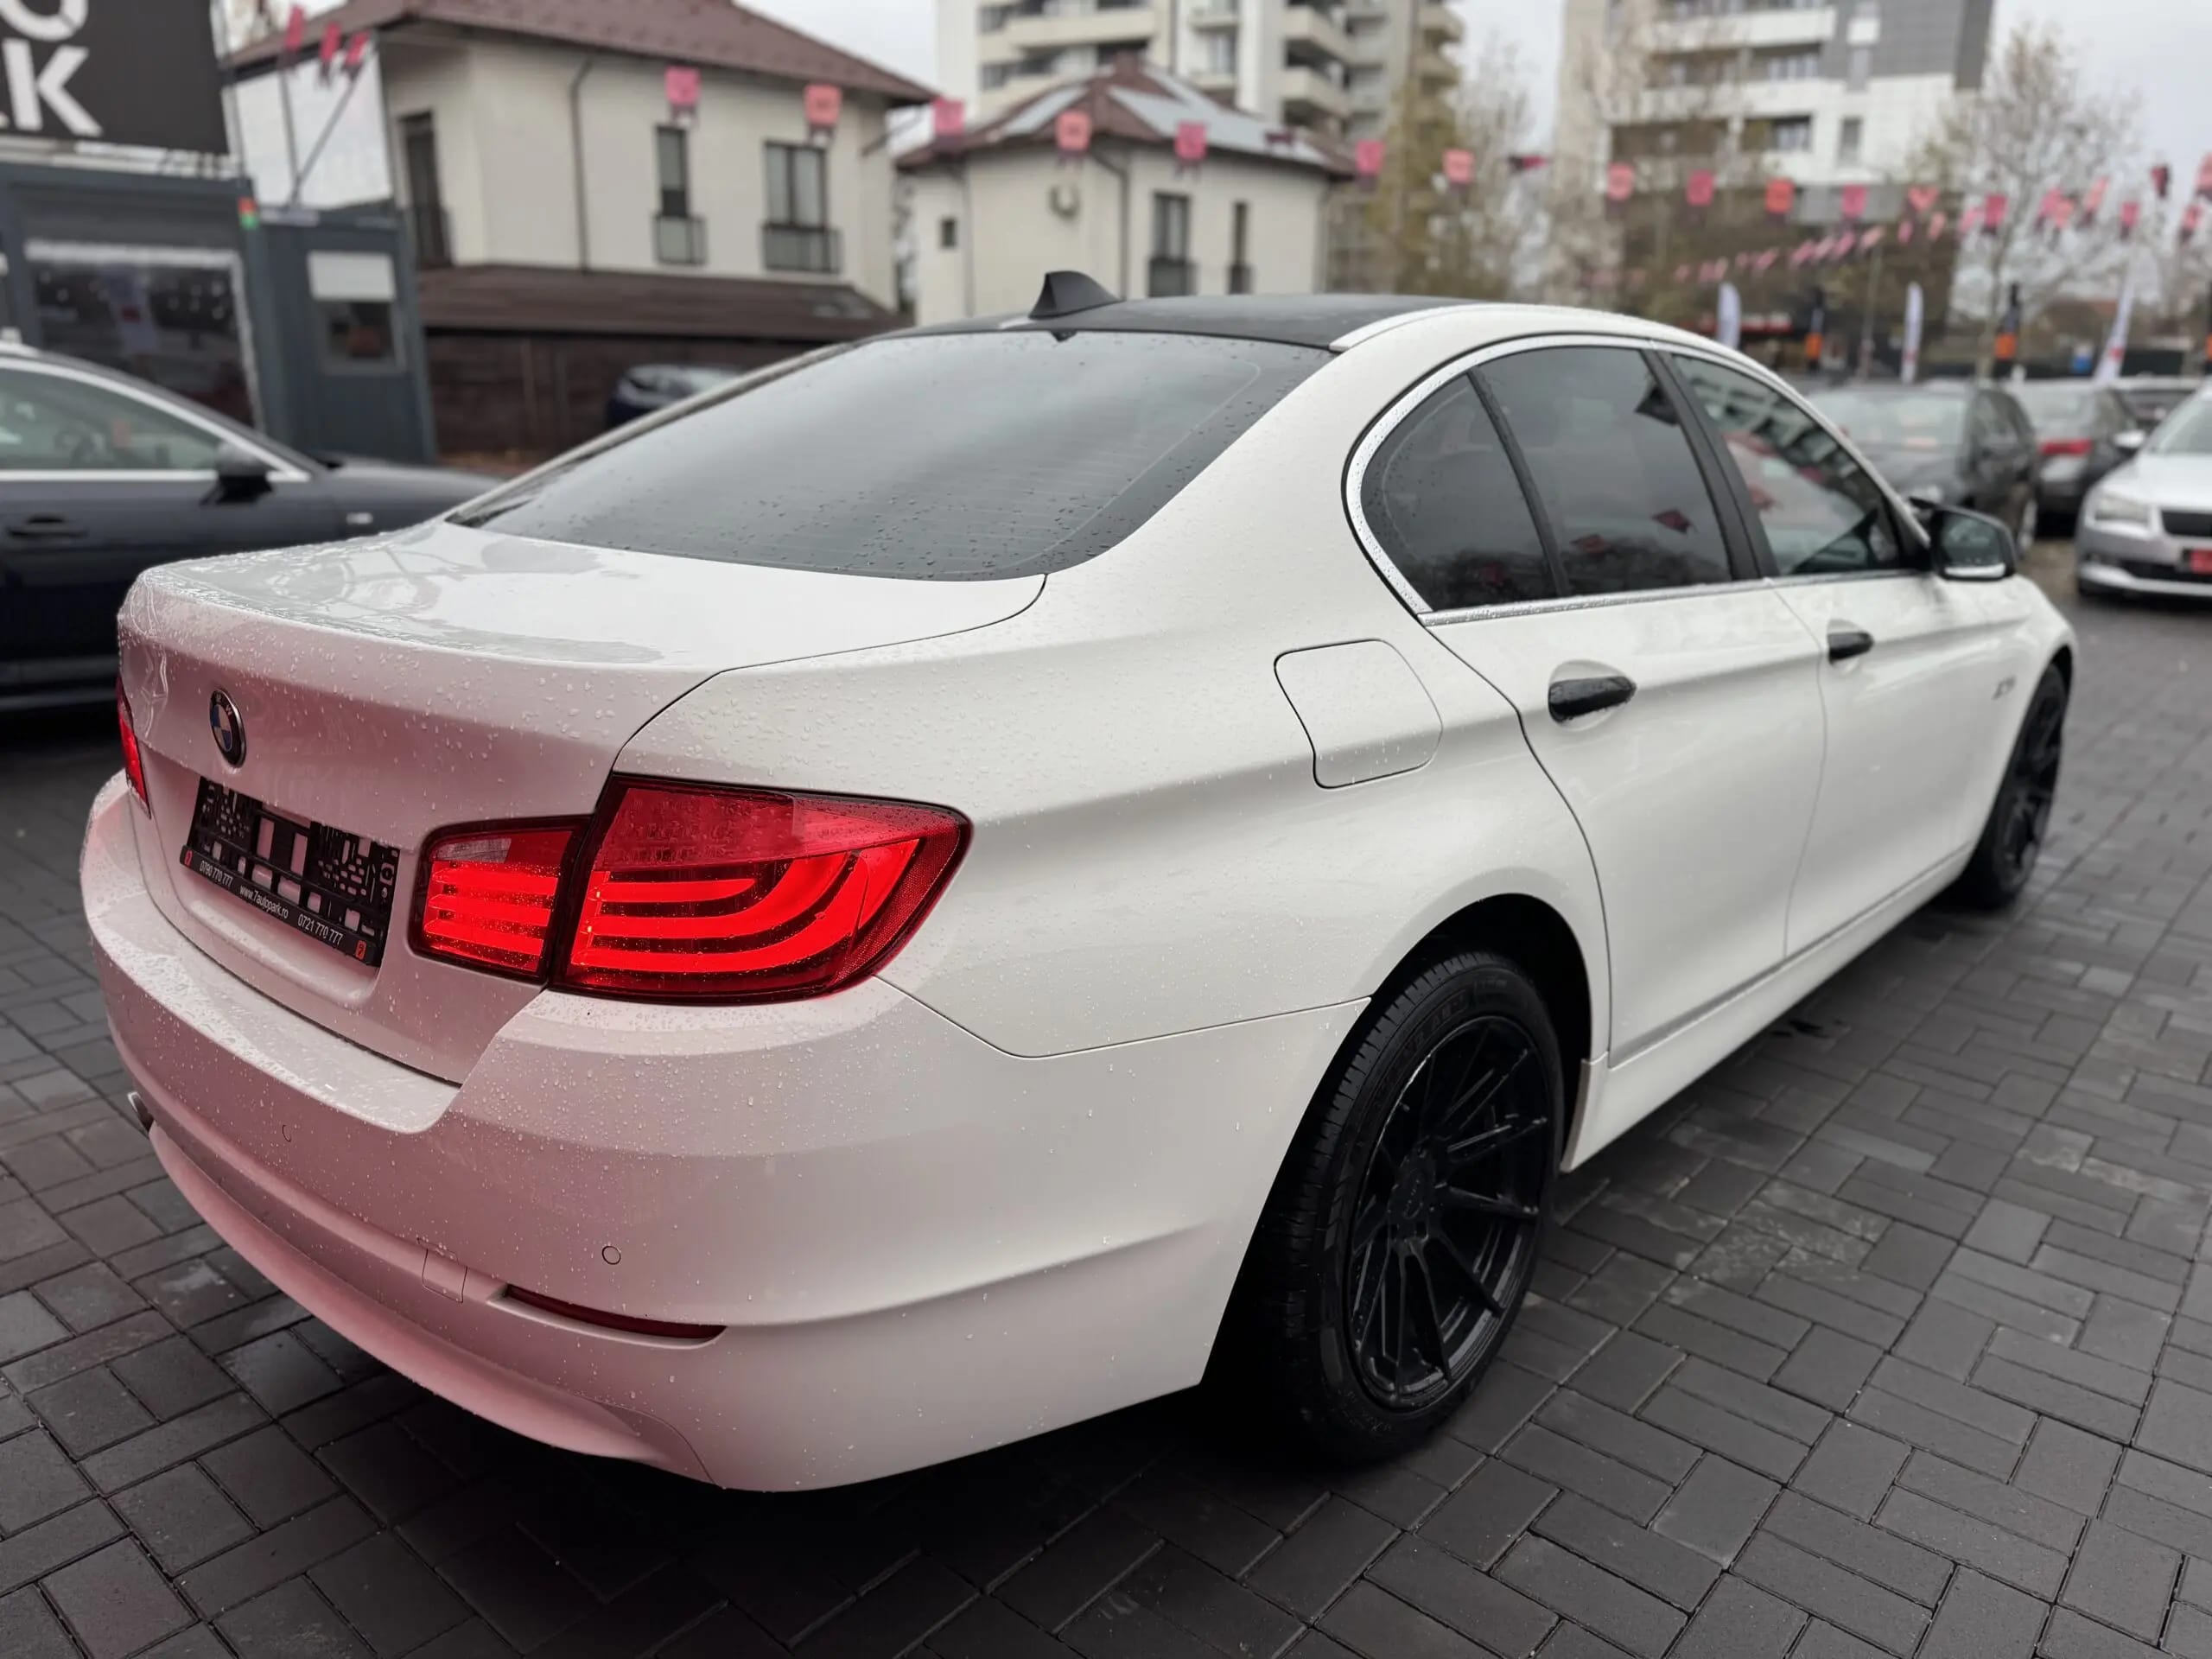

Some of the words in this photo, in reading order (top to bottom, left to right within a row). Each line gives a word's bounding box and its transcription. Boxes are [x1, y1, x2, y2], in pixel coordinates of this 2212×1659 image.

[0, 37, 104, 137] K
[200, 861, 213, 876] 0790
[213, 867, 223, 881] 770
[222, 874, 233, 887] 777
[239, 886, 289, 918] www.7autopark.ro
[298, 913, 315, 932] 0721
[315, 922, 329, 939] 770
[329, 929, 344, 945] 777
